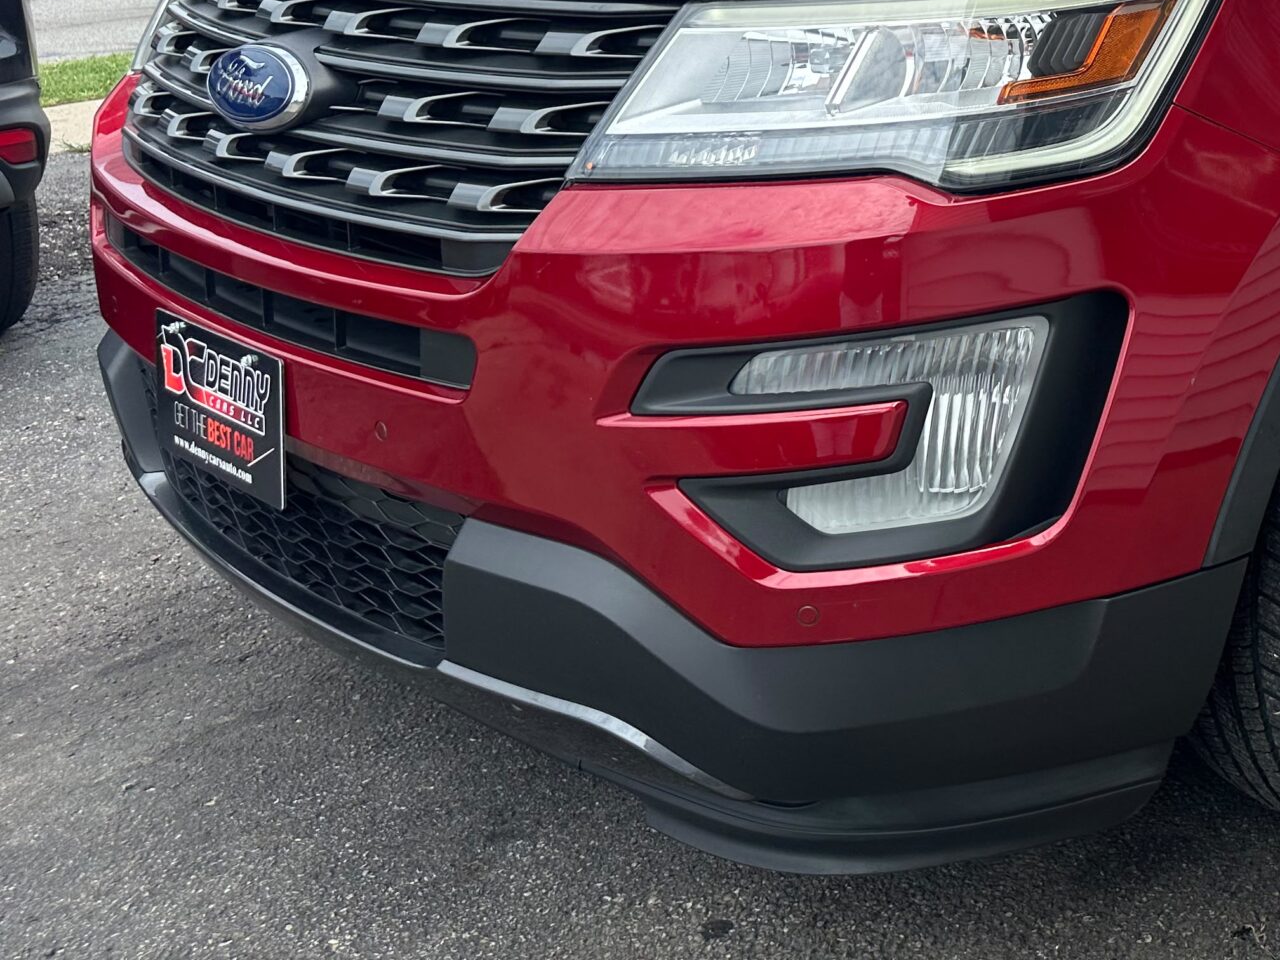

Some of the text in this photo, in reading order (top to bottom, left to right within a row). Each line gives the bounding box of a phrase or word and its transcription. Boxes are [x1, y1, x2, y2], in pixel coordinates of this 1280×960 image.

[217, 54, 273, 104] Ford
[205, 348, 271, 415] DENNY
[174, 400, 255, 463] GET THE BEST CAR
[209, 395, 260, 429] CARS LLC
[174, 434, 253, 484] www.dennycarsauto.com
